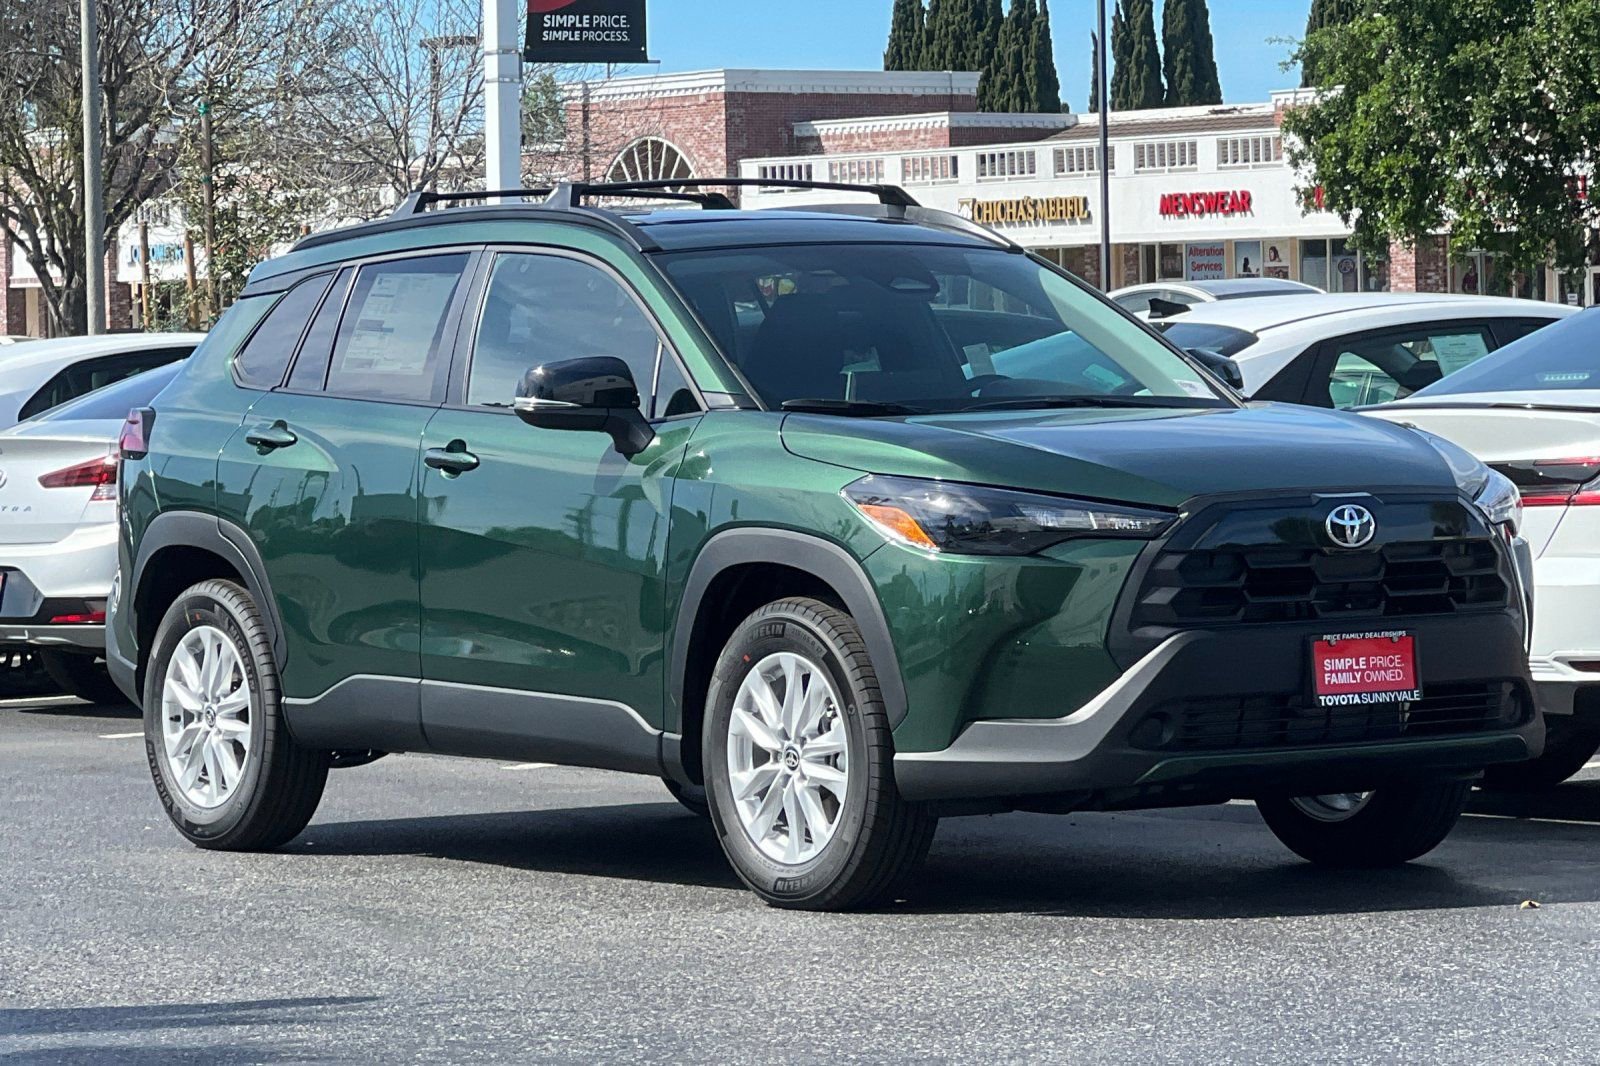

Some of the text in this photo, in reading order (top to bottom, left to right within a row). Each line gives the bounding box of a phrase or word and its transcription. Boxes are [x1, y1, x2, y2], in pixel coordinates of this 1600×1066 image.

[543, 14, 630, 28] SIMPLE PRICE.
[542, 30, 630, 41] SIMPLE PROCESS.
[973, 196, 1088, 223] CHICHA'S MEHFIL
[1159, 190, 1252, 216] MENSWEAR
[1191, 261, 1222, 272] Services
[1322, 630, 1407, 641] PRICE FAMILY DEALERSHIPS
[1323, 654, 1405, 671] SIMPLE PRICE.
[1324, 669, 1406, 685] FAMILY OWNED.
[1319, 689, 1421, 706] TOYOTA SUNNYVALE
